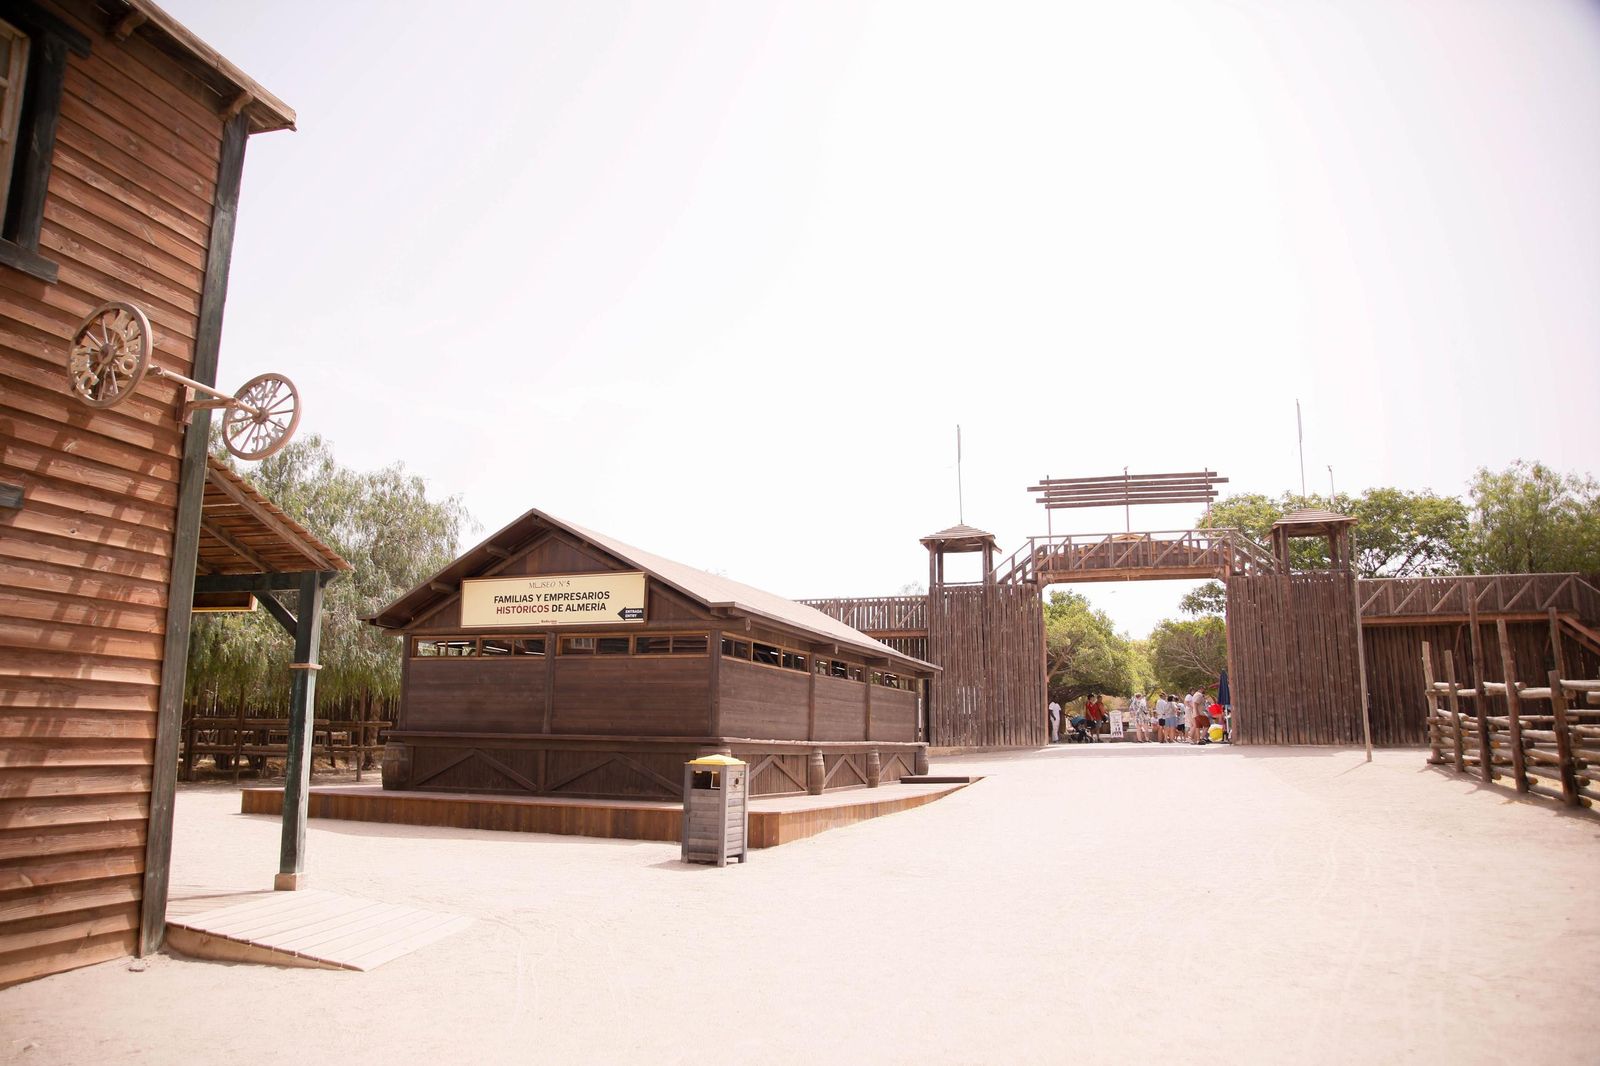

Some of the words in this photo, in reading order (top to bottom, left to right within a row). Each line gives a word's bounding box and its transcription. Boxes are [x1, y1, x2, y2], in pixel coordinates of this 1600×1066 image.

[494, 593, 534, 604] FAMILIAS
[535, 592, 542, 602] Y
[543, 590, 610, 602] EMPRESARIOS
[496, 602, 550, 614] HISTÓRICOS
[551, 603, 563, 613] DE
[565, 601, 607, 612] ALMERÍA
